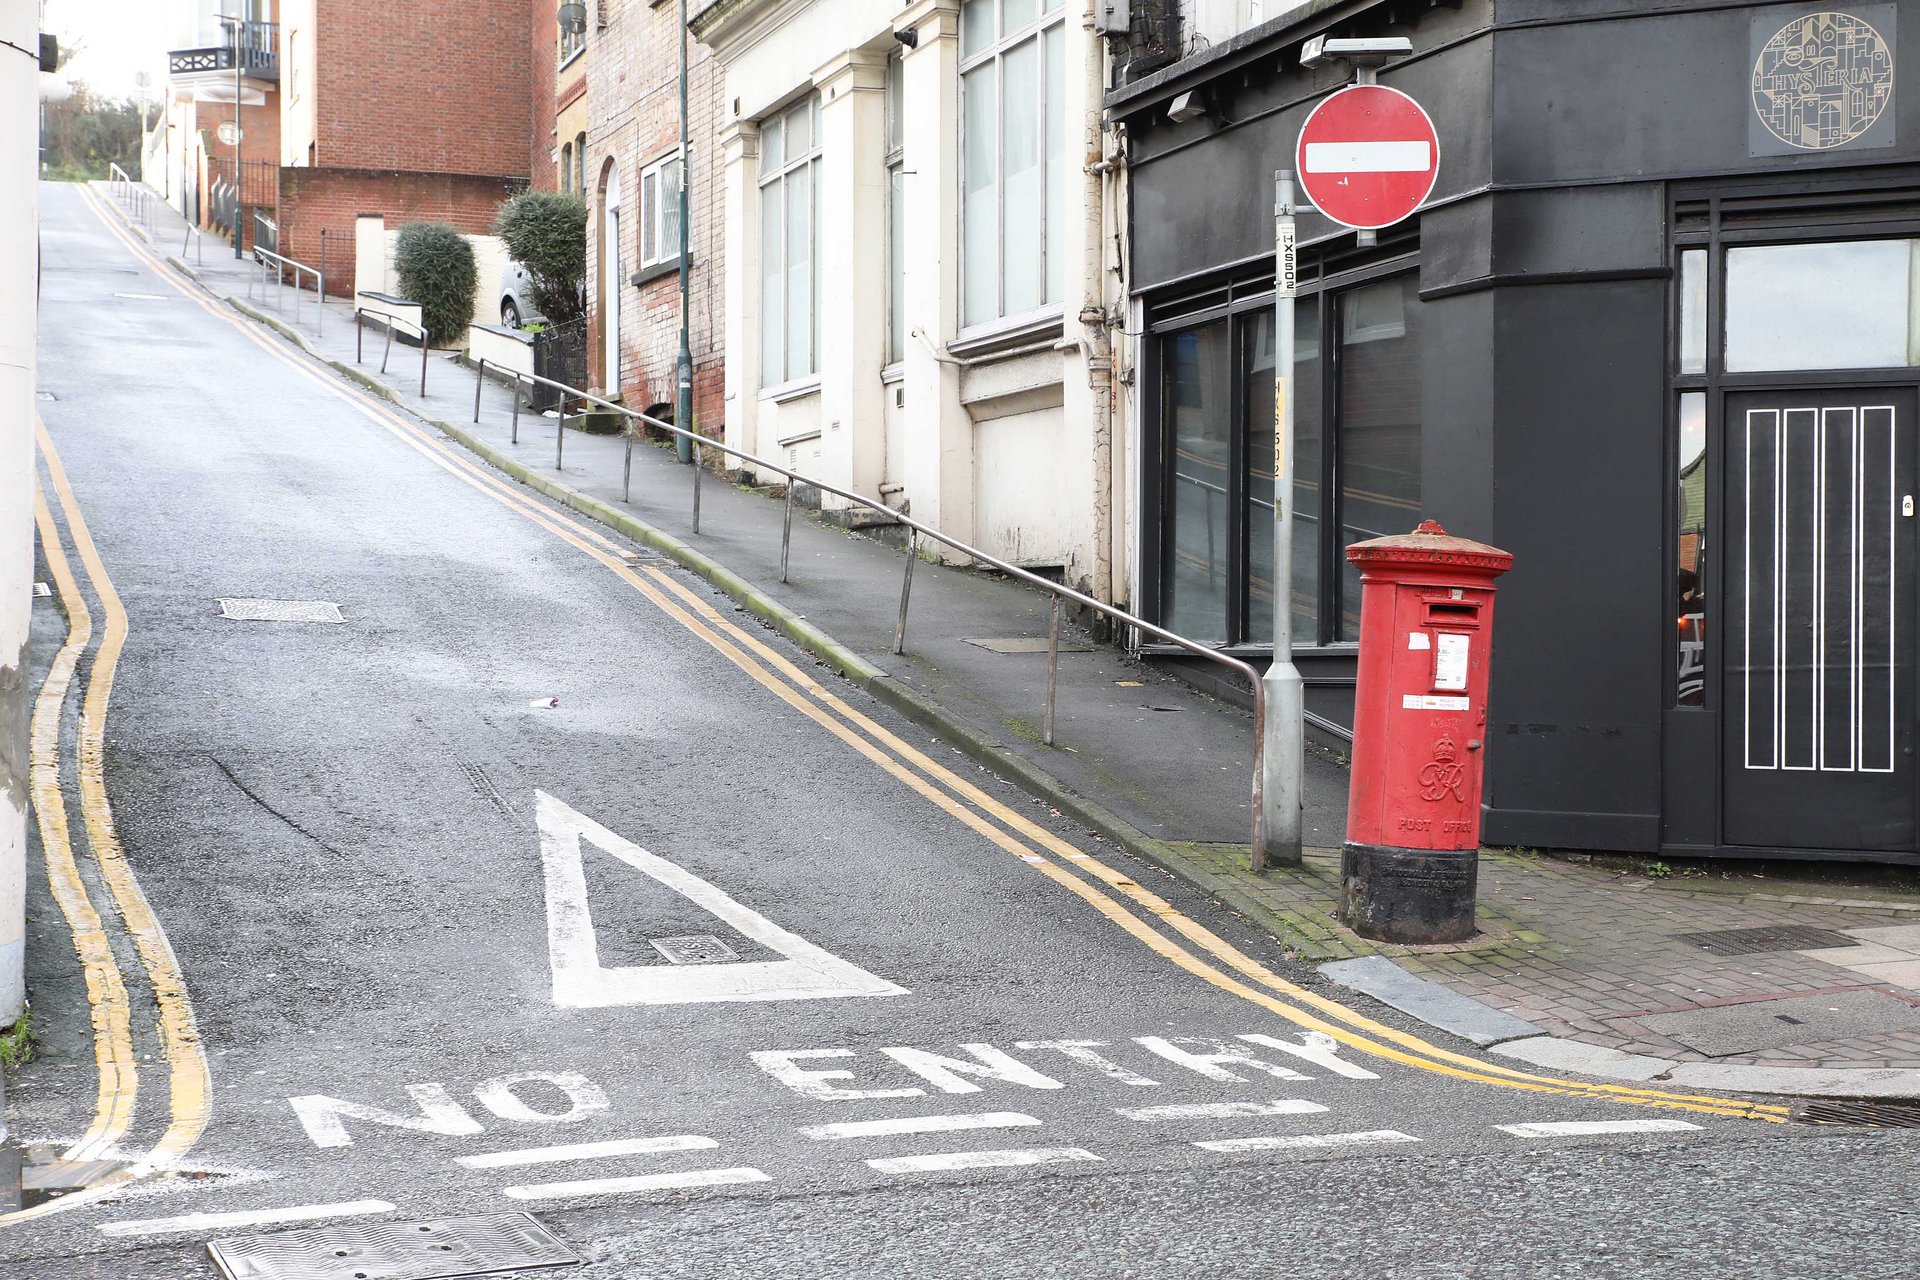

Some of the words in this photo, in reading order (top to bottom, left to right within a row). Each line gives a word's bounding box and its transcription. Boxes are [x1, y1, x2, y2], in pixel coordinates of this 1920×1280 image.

[1771, 58, 1873, 96] HYSTERIA
[1283, 235, 1295, 290] HXS502
[1398, 818, 1432, 832] POST
[1443, 820, 1472, 834] OFFICE
[288, 1070, 610, 1149] NO
[748, 1031, 1382, 1103] ENTRY
